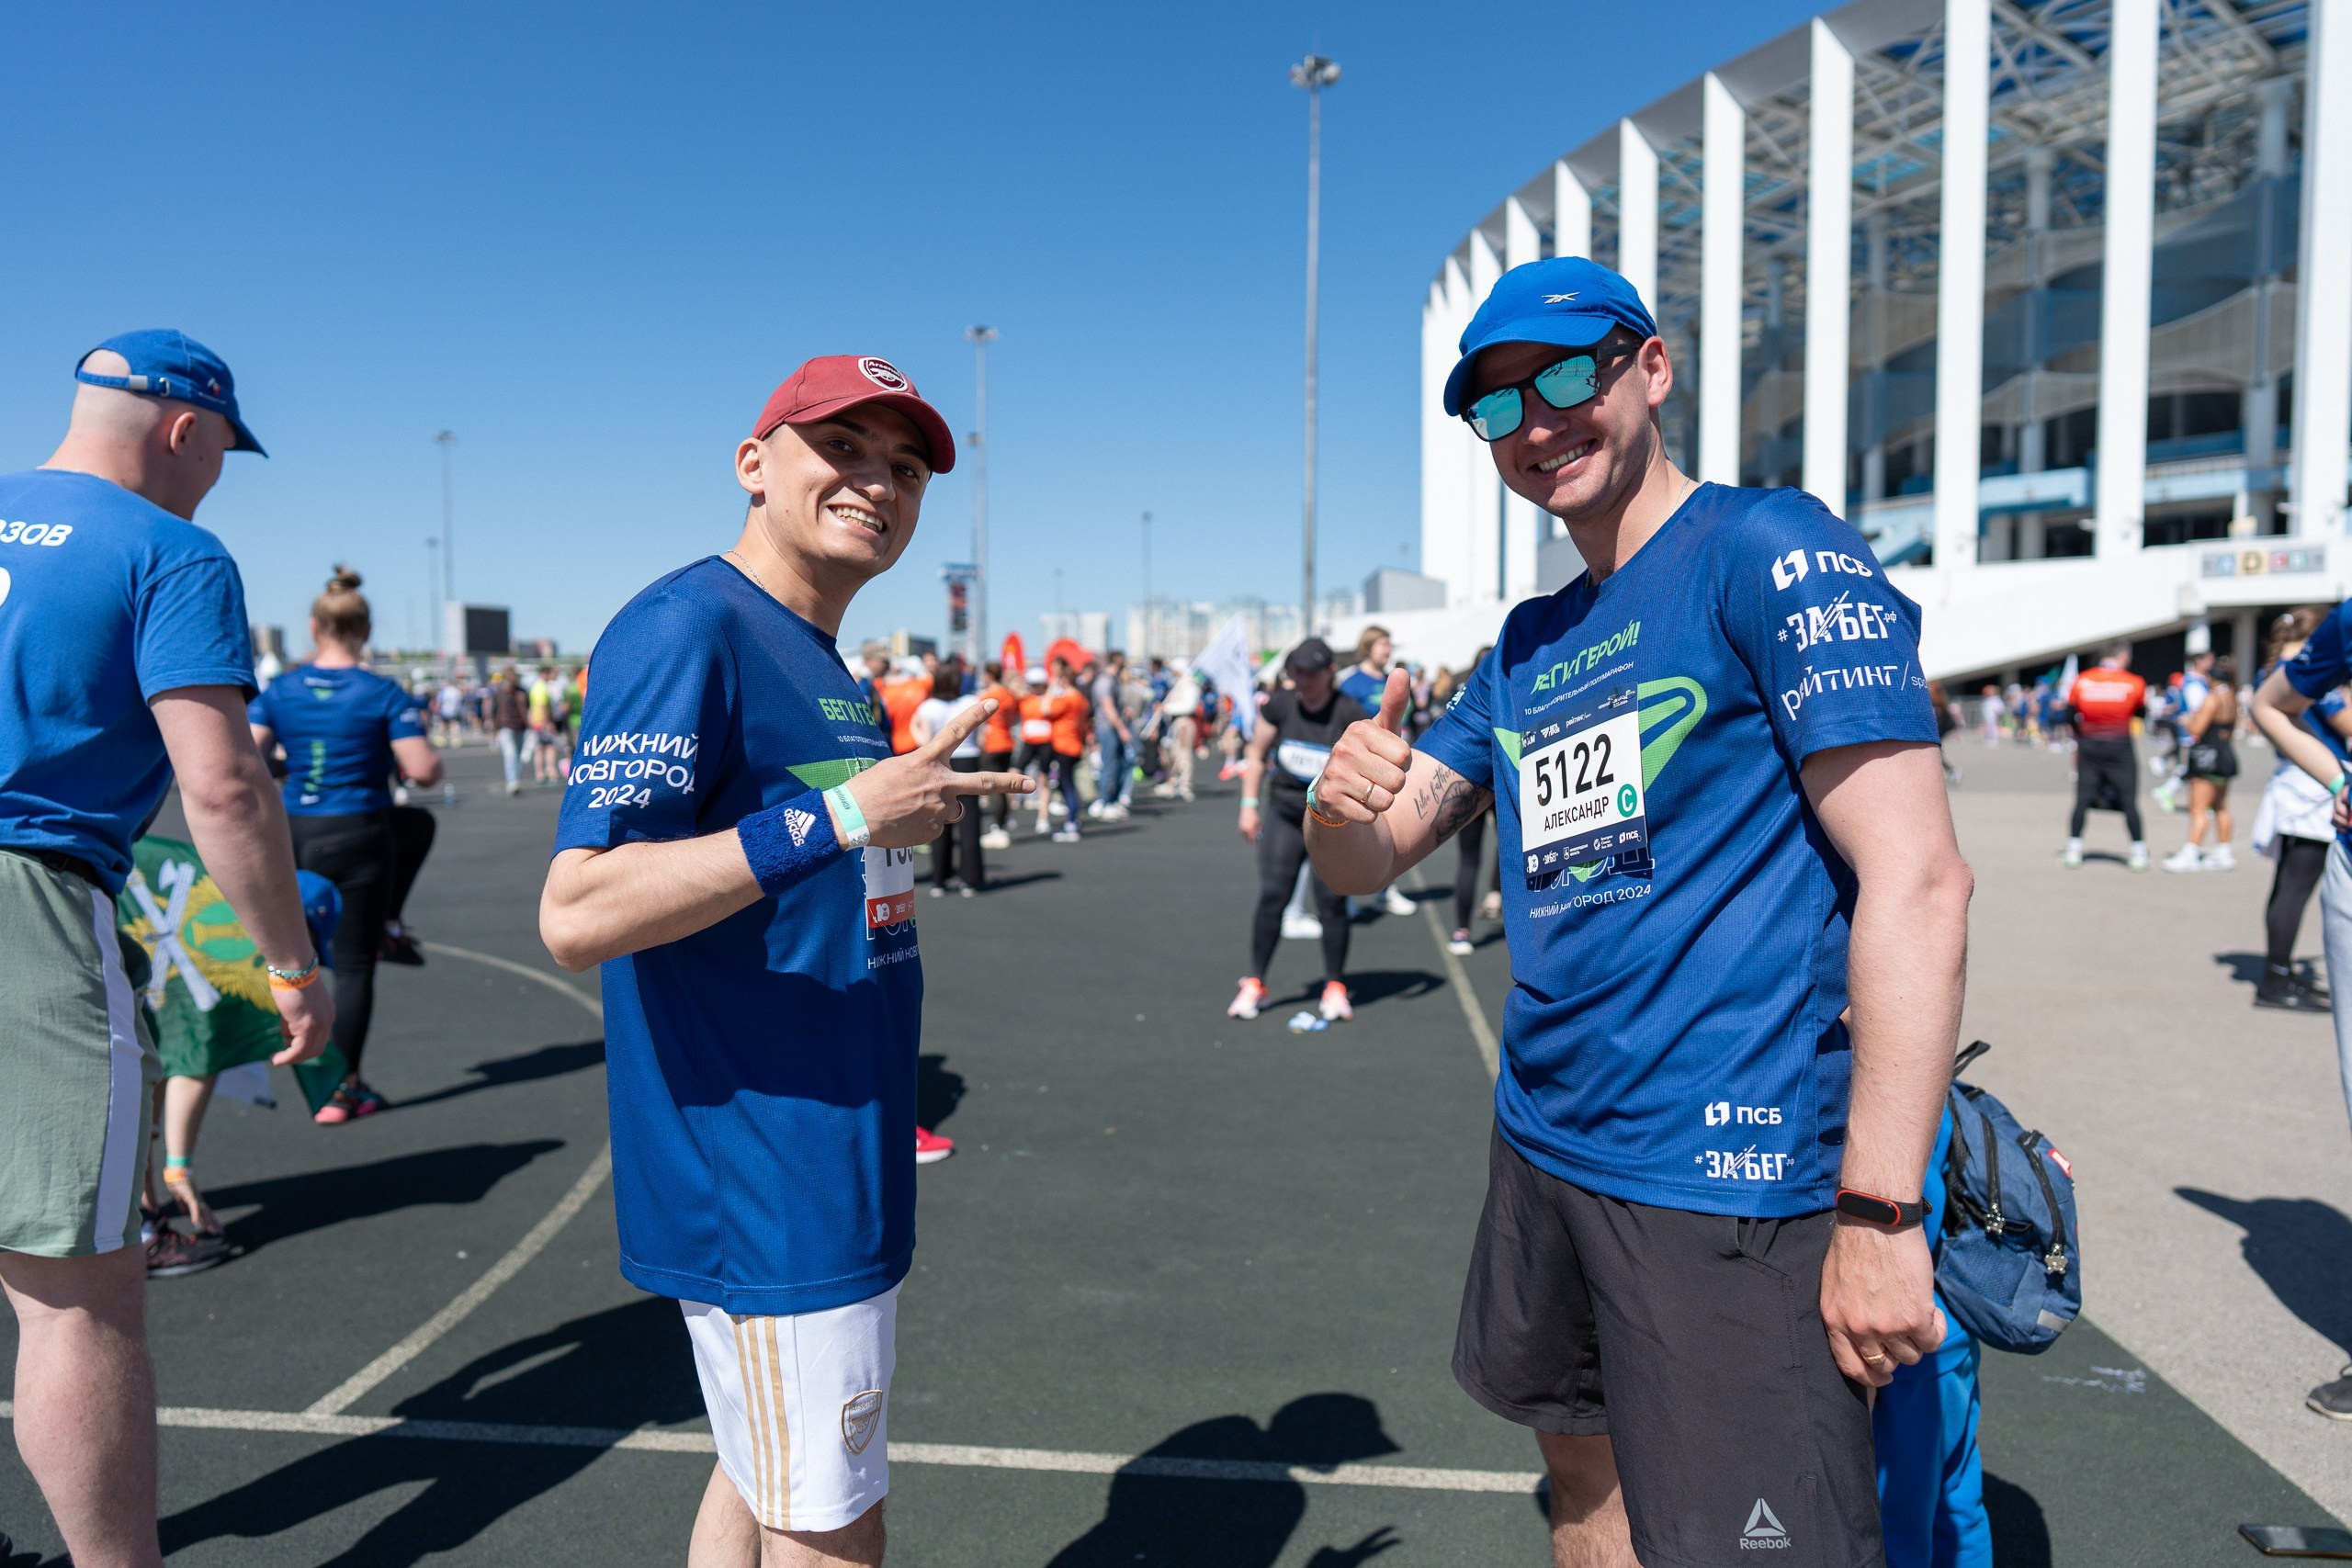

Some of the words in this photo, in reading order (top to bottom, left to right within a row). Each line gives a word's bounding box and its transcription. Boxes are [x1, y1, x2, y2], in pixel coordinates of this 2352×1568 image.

[1815, 550, 1873, 578] ПСБ
[1535, 733, 1614, 807] 5122
[588, 784, 652, 809] 2024
[1544, 795, 1610, 832] АЛЕКСАНДР
[784, 808, 805, 848] adidas
[1616, 884, 1652, 901] 2024
[1736, 1106, 1782, 1125] ПСБ
[1739, 1537, 1792, 1551] Reebok
